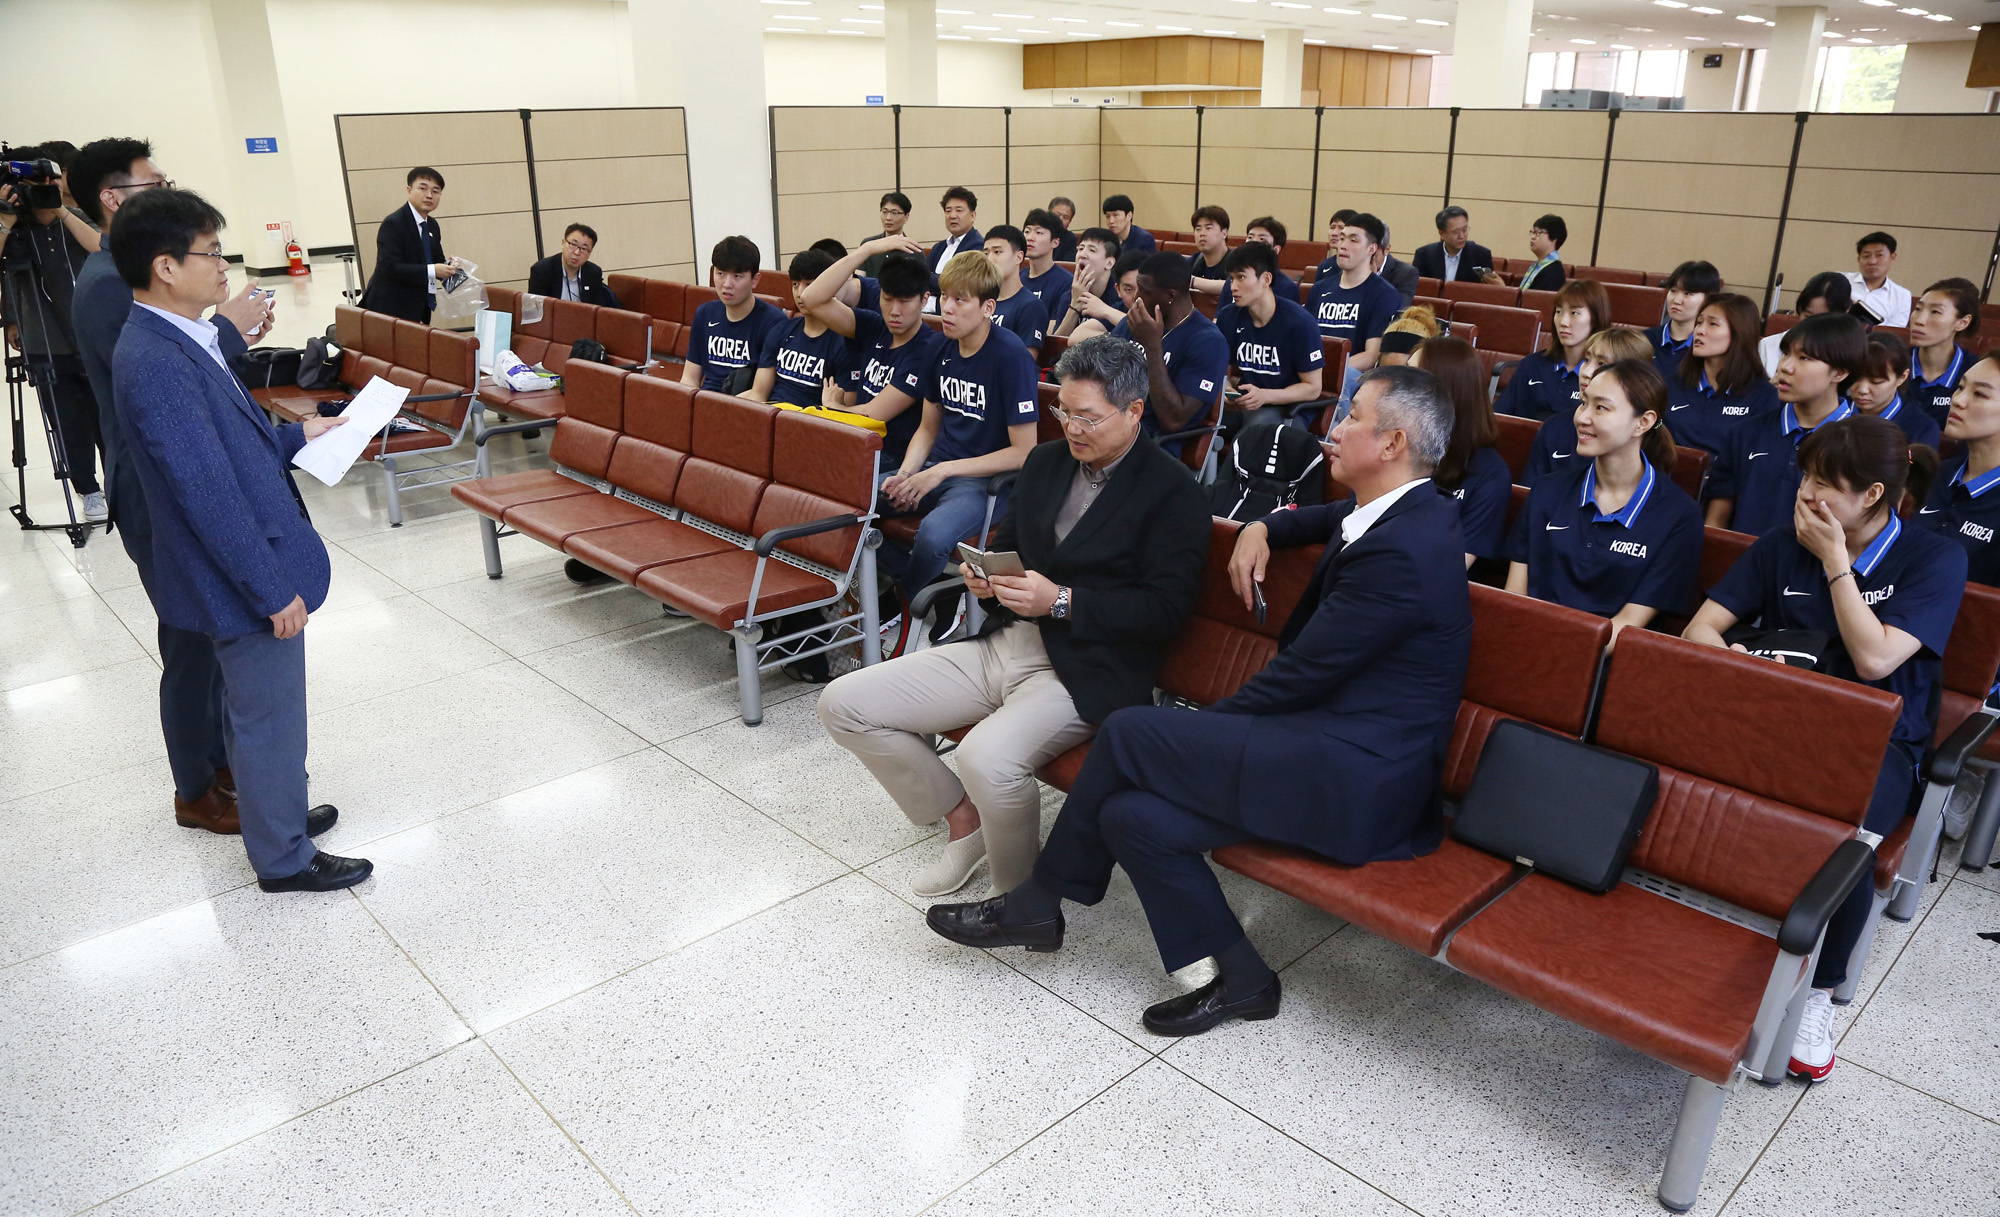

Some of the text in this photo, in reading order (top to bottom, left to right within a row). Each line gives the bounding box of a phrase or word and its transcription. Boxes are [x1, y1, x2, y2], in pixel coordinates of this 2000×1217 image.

[1317, 302, 1360, 321] KOREA
[708, 335, 751, 361] KOREA
[1237, 341, 1280, 367] KOREA
[776, 347, 825, 380] KOREA
[864, 357, 895, 388] KOREA
[940, 375, 986, 411] KOREA
[1932, 396, 1952, 406] KOR
[1722, 406, 1750, 416] KOREA
[1959, 520, 1995, 543] KOREA
[1609, 539, 1648, 559] KOREA
